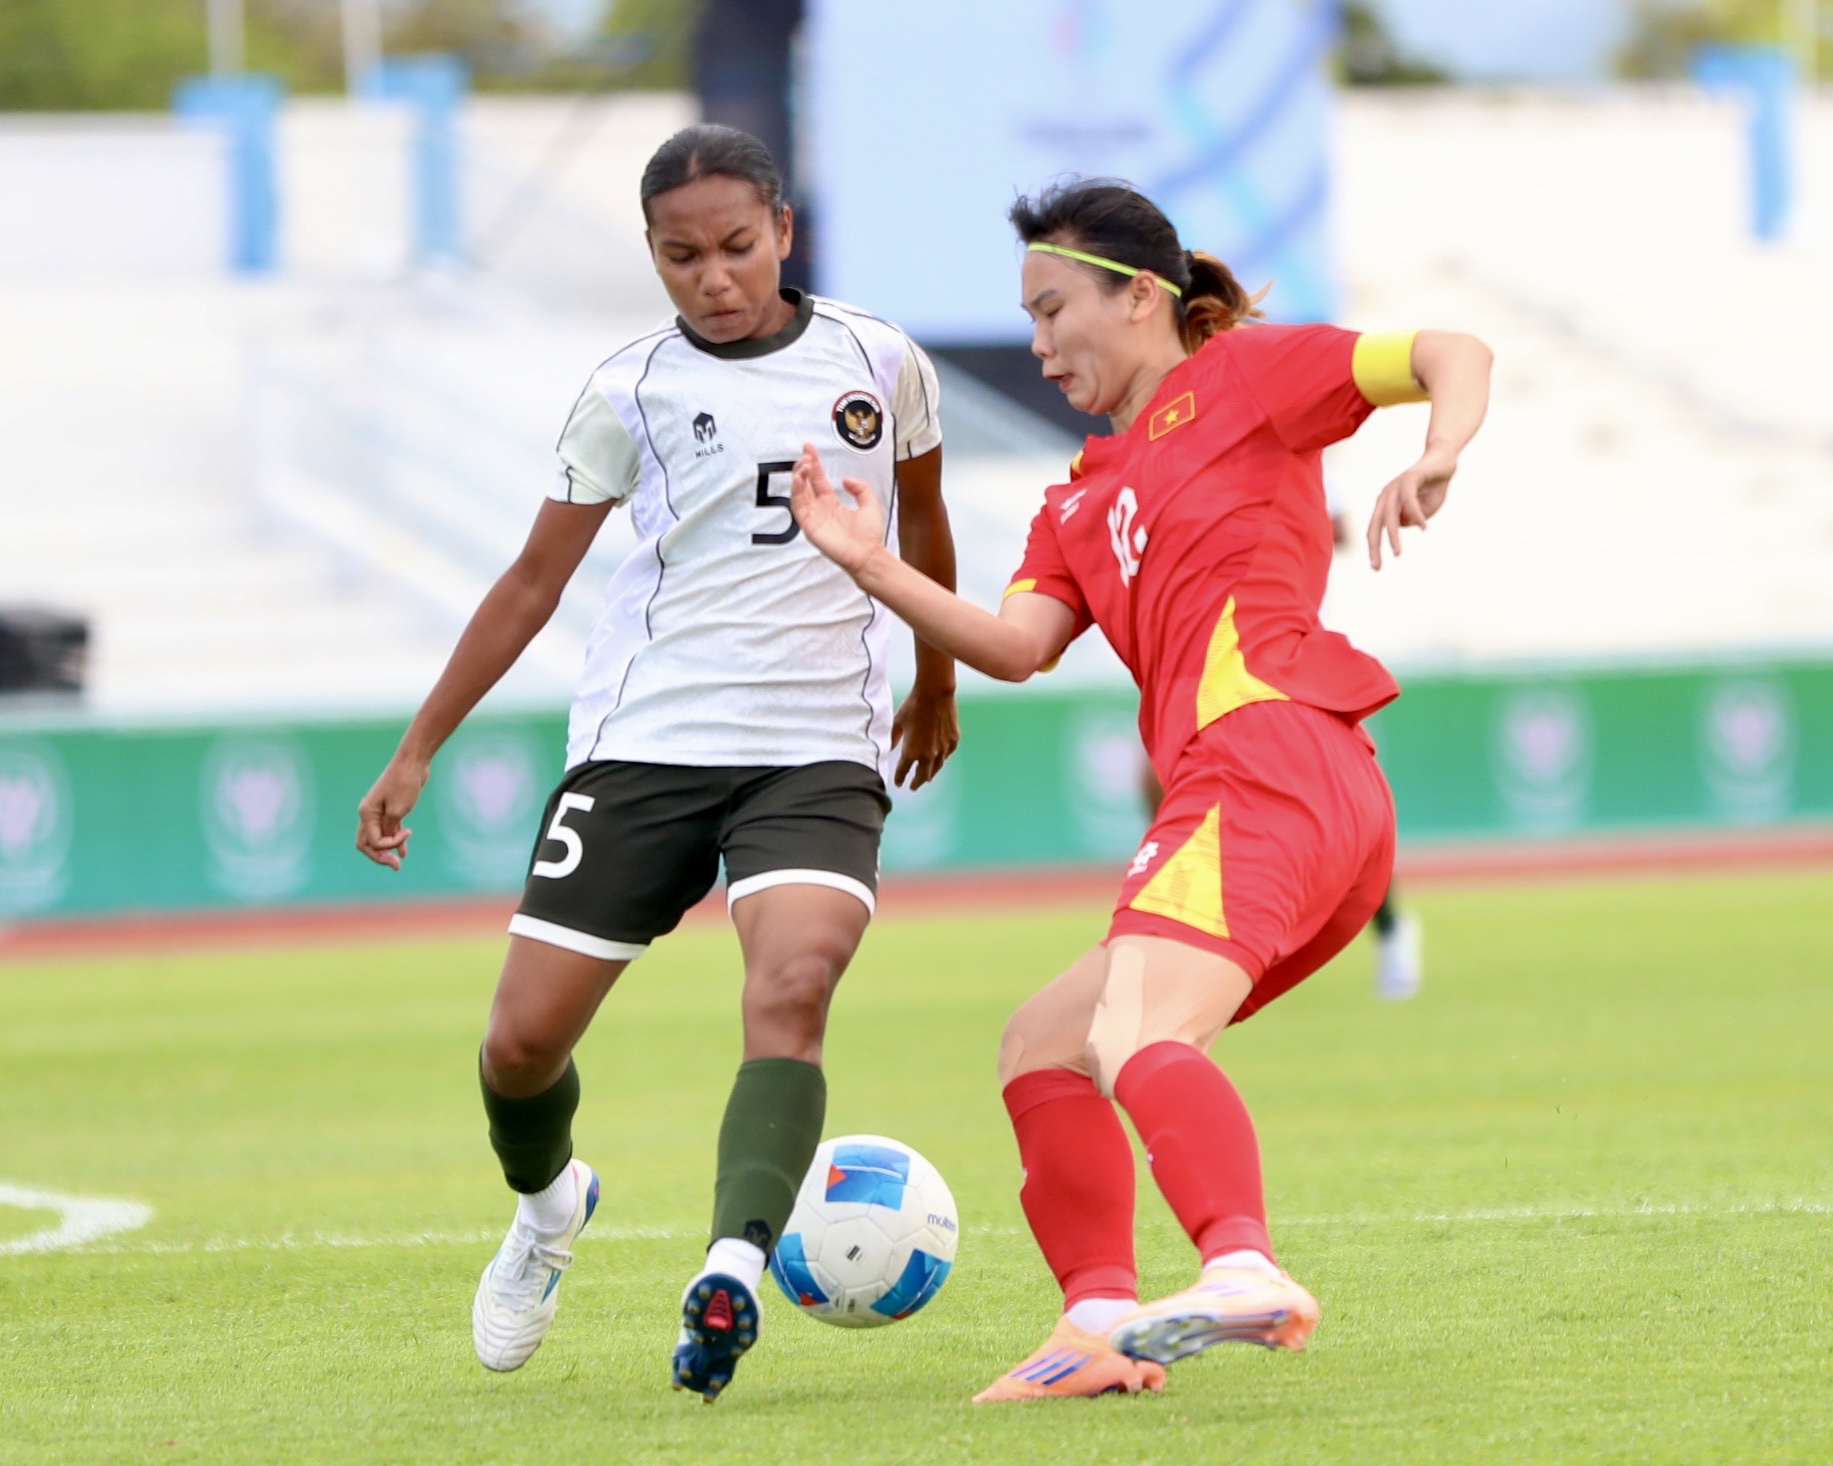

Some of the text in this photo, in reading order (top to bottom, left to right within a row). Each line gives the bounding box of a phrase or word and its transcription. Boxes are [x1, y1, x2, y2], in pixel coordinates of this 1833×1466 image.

[694, 443, 725, 460] MILLS
[751, 460, 802, 545] 5
[532, 791, 596, 879] 5
